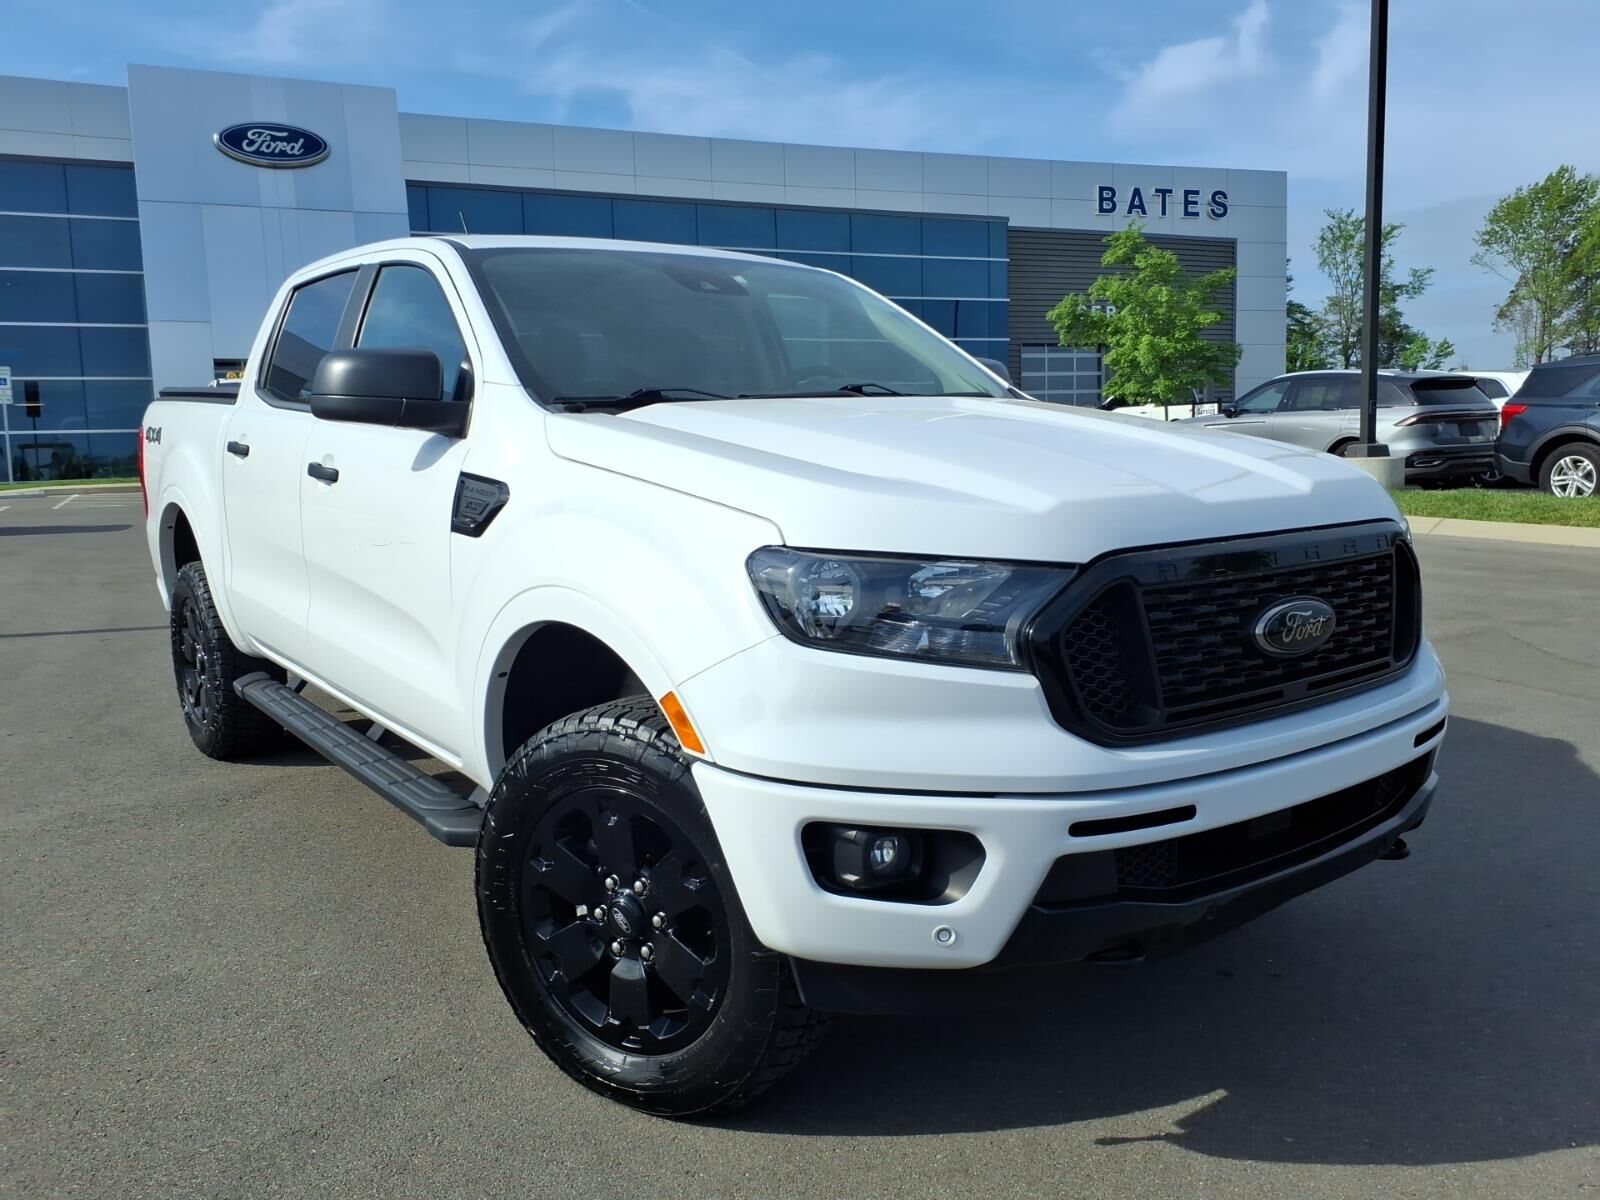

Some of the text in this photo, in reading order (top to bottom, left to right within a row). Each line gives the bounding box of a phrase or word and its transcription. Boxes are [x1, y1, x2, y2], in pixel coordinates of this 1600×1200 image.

[242, 129, 304, 155] Ford
[1097, 185, 1229, 219] BATES
[1283, 611, 1326, 642] Ford
